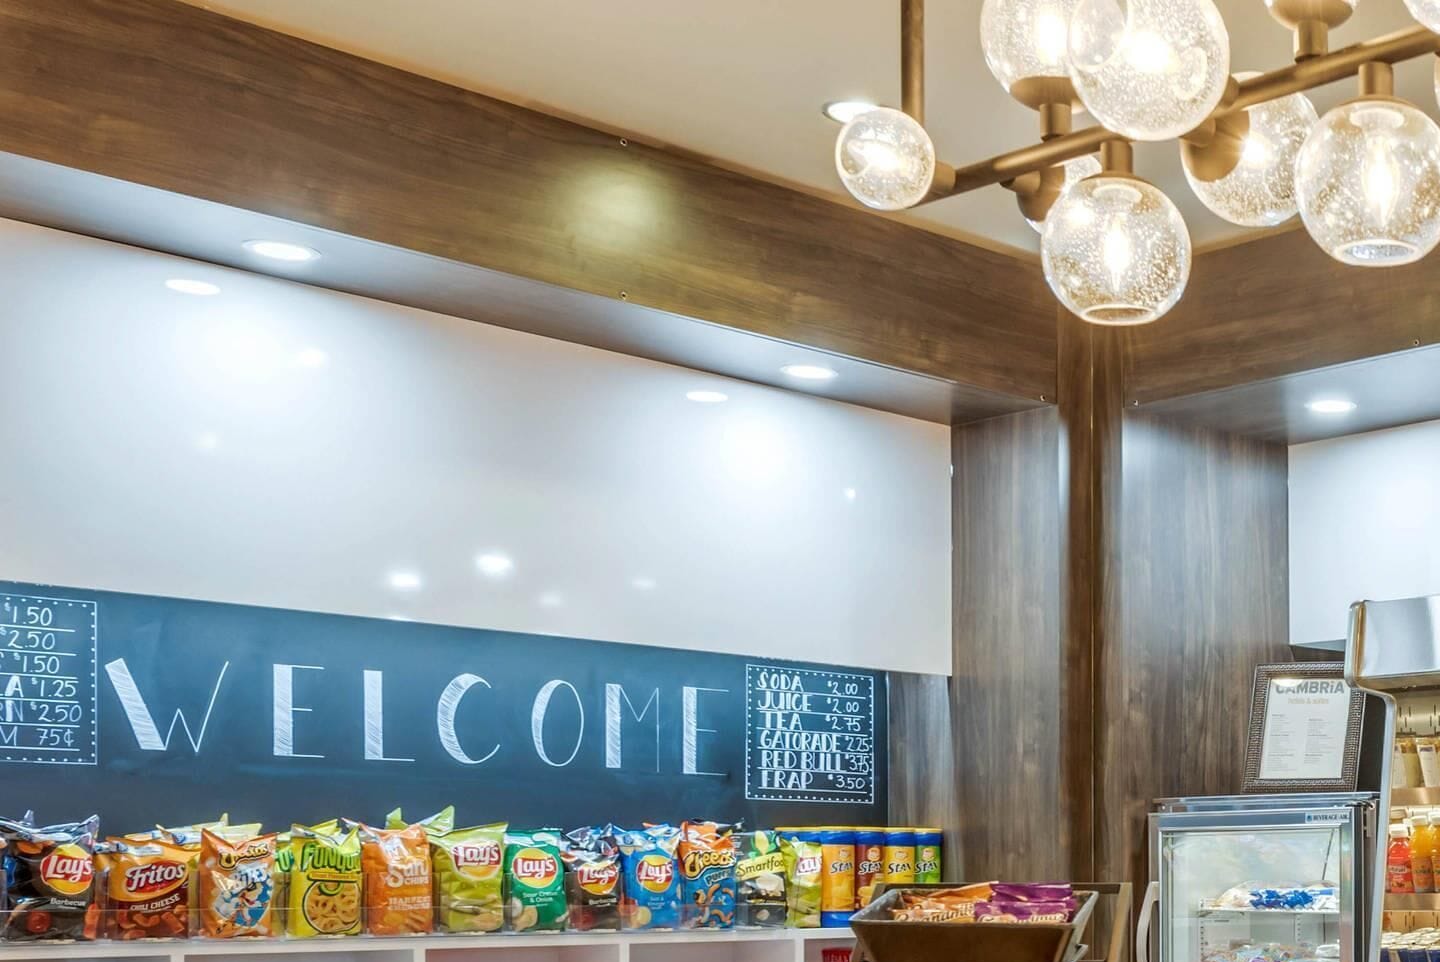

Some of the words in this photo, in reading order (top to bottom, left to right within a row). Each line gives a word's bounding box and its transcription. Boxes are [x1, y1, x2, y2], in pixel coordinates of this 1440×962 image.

[4, 602, 53, 626] $1.50
[0, 627, 56, 650] $2.50
[13, 652, 60, 675] $1.50
[31, 677, 79, 697] $1.25
[757, 671, 804, 692] SODA
[827, 680, 859, 695] $2.00
[30, 701, 82, 723] $2.50
[758, 690, 812, 712] JUICE
[827, 697, 860, 714] $2.00
[105, 658, 729, 777] WELCOME
[759, 710, 803, 731] TEA
[760, 729, 841, 753] GATORADE
[761, 750, 798, 769] RED
[800, 751, 847, 772] BULL
[761, 769, 814, 789] FRAP
[46, 854, 93, 883] Lay's
[125, 862, 187, 892] Fritos
[516, 856, 555, 879] Lay's
[582, 865, 617, 885] Lay's
[639, 860, 673, 882] Lay's
[737, 855, 786, 876] Smartfoo
